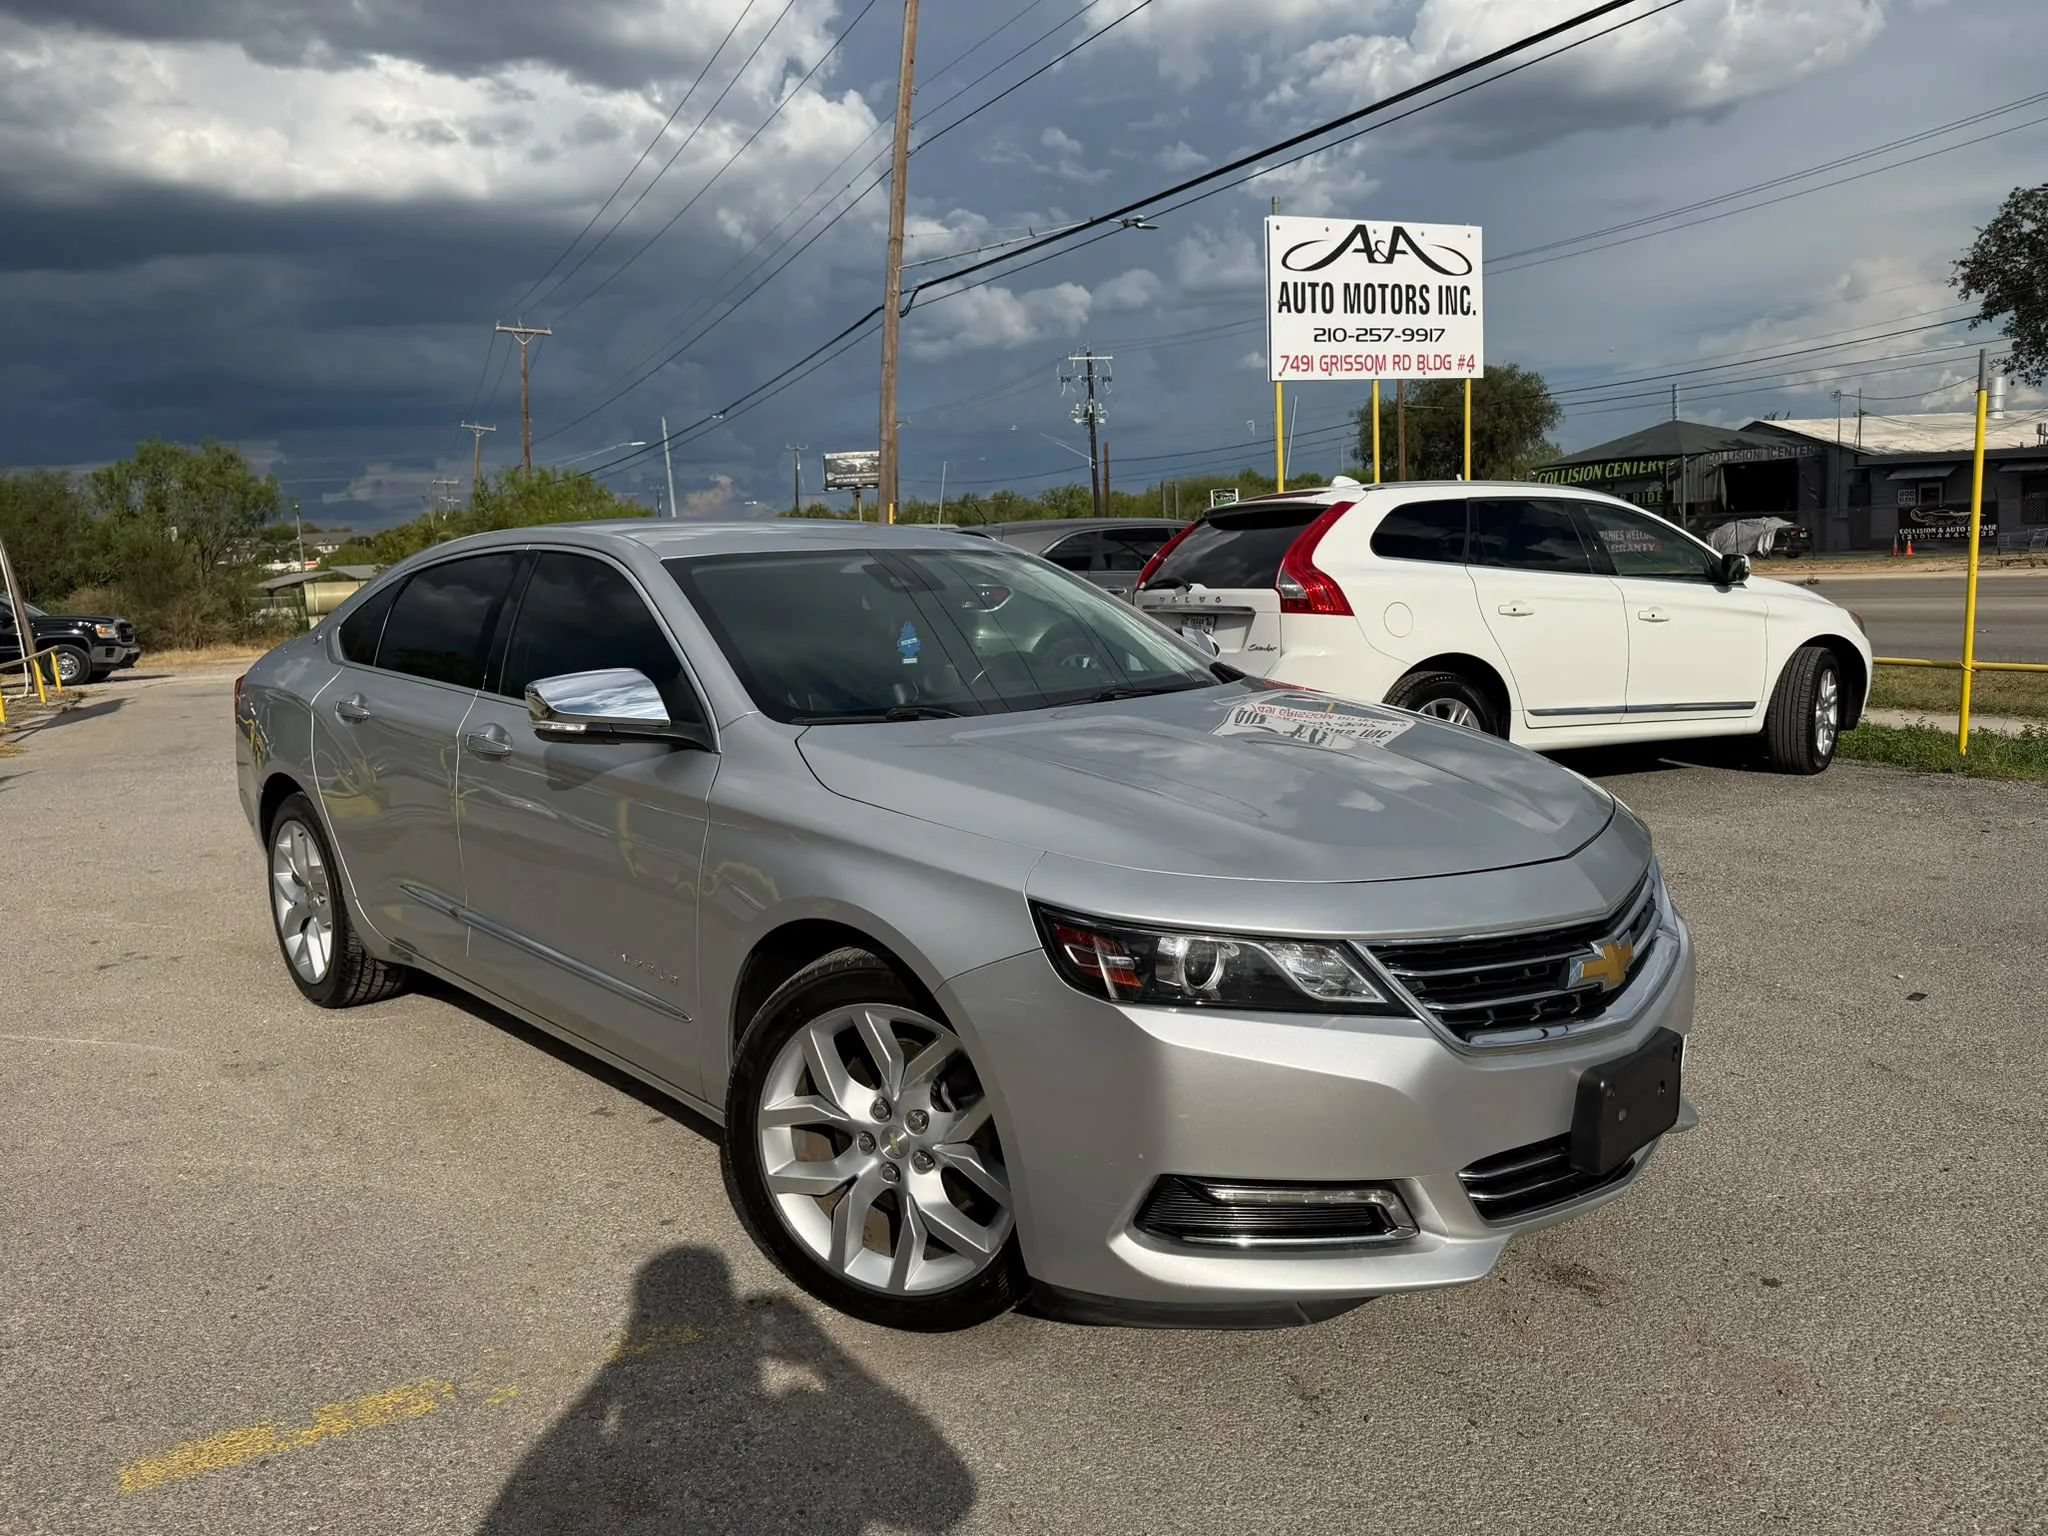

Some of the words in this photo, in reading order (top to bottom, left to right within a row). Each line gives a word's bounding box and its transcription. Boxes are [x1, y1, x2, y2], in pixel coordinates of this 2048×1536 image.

[1281, 224, 1473, 276] A&A
[1278, 281, 1334, 314] AUTO
[1343, 282, 1430, 315] MOTORS
[1437, 284, 1477, 316] INC.
[1313, 327, 1446, 343] 210-257-9917
[1279, 354, 1315, 373] 7491
[1319, 353, 1387, 372] GRISSOM
[1392, 353, 1412, 371] RD
[1417, 353, 1452, 371] BLDG
[1457, 353, 1476, 371] #4
[1707, 449, 1762, 465] COLLISION
[1538, 463, 1603, 484] COLLISION
[1632, 491, 1663, 504] RIDE
